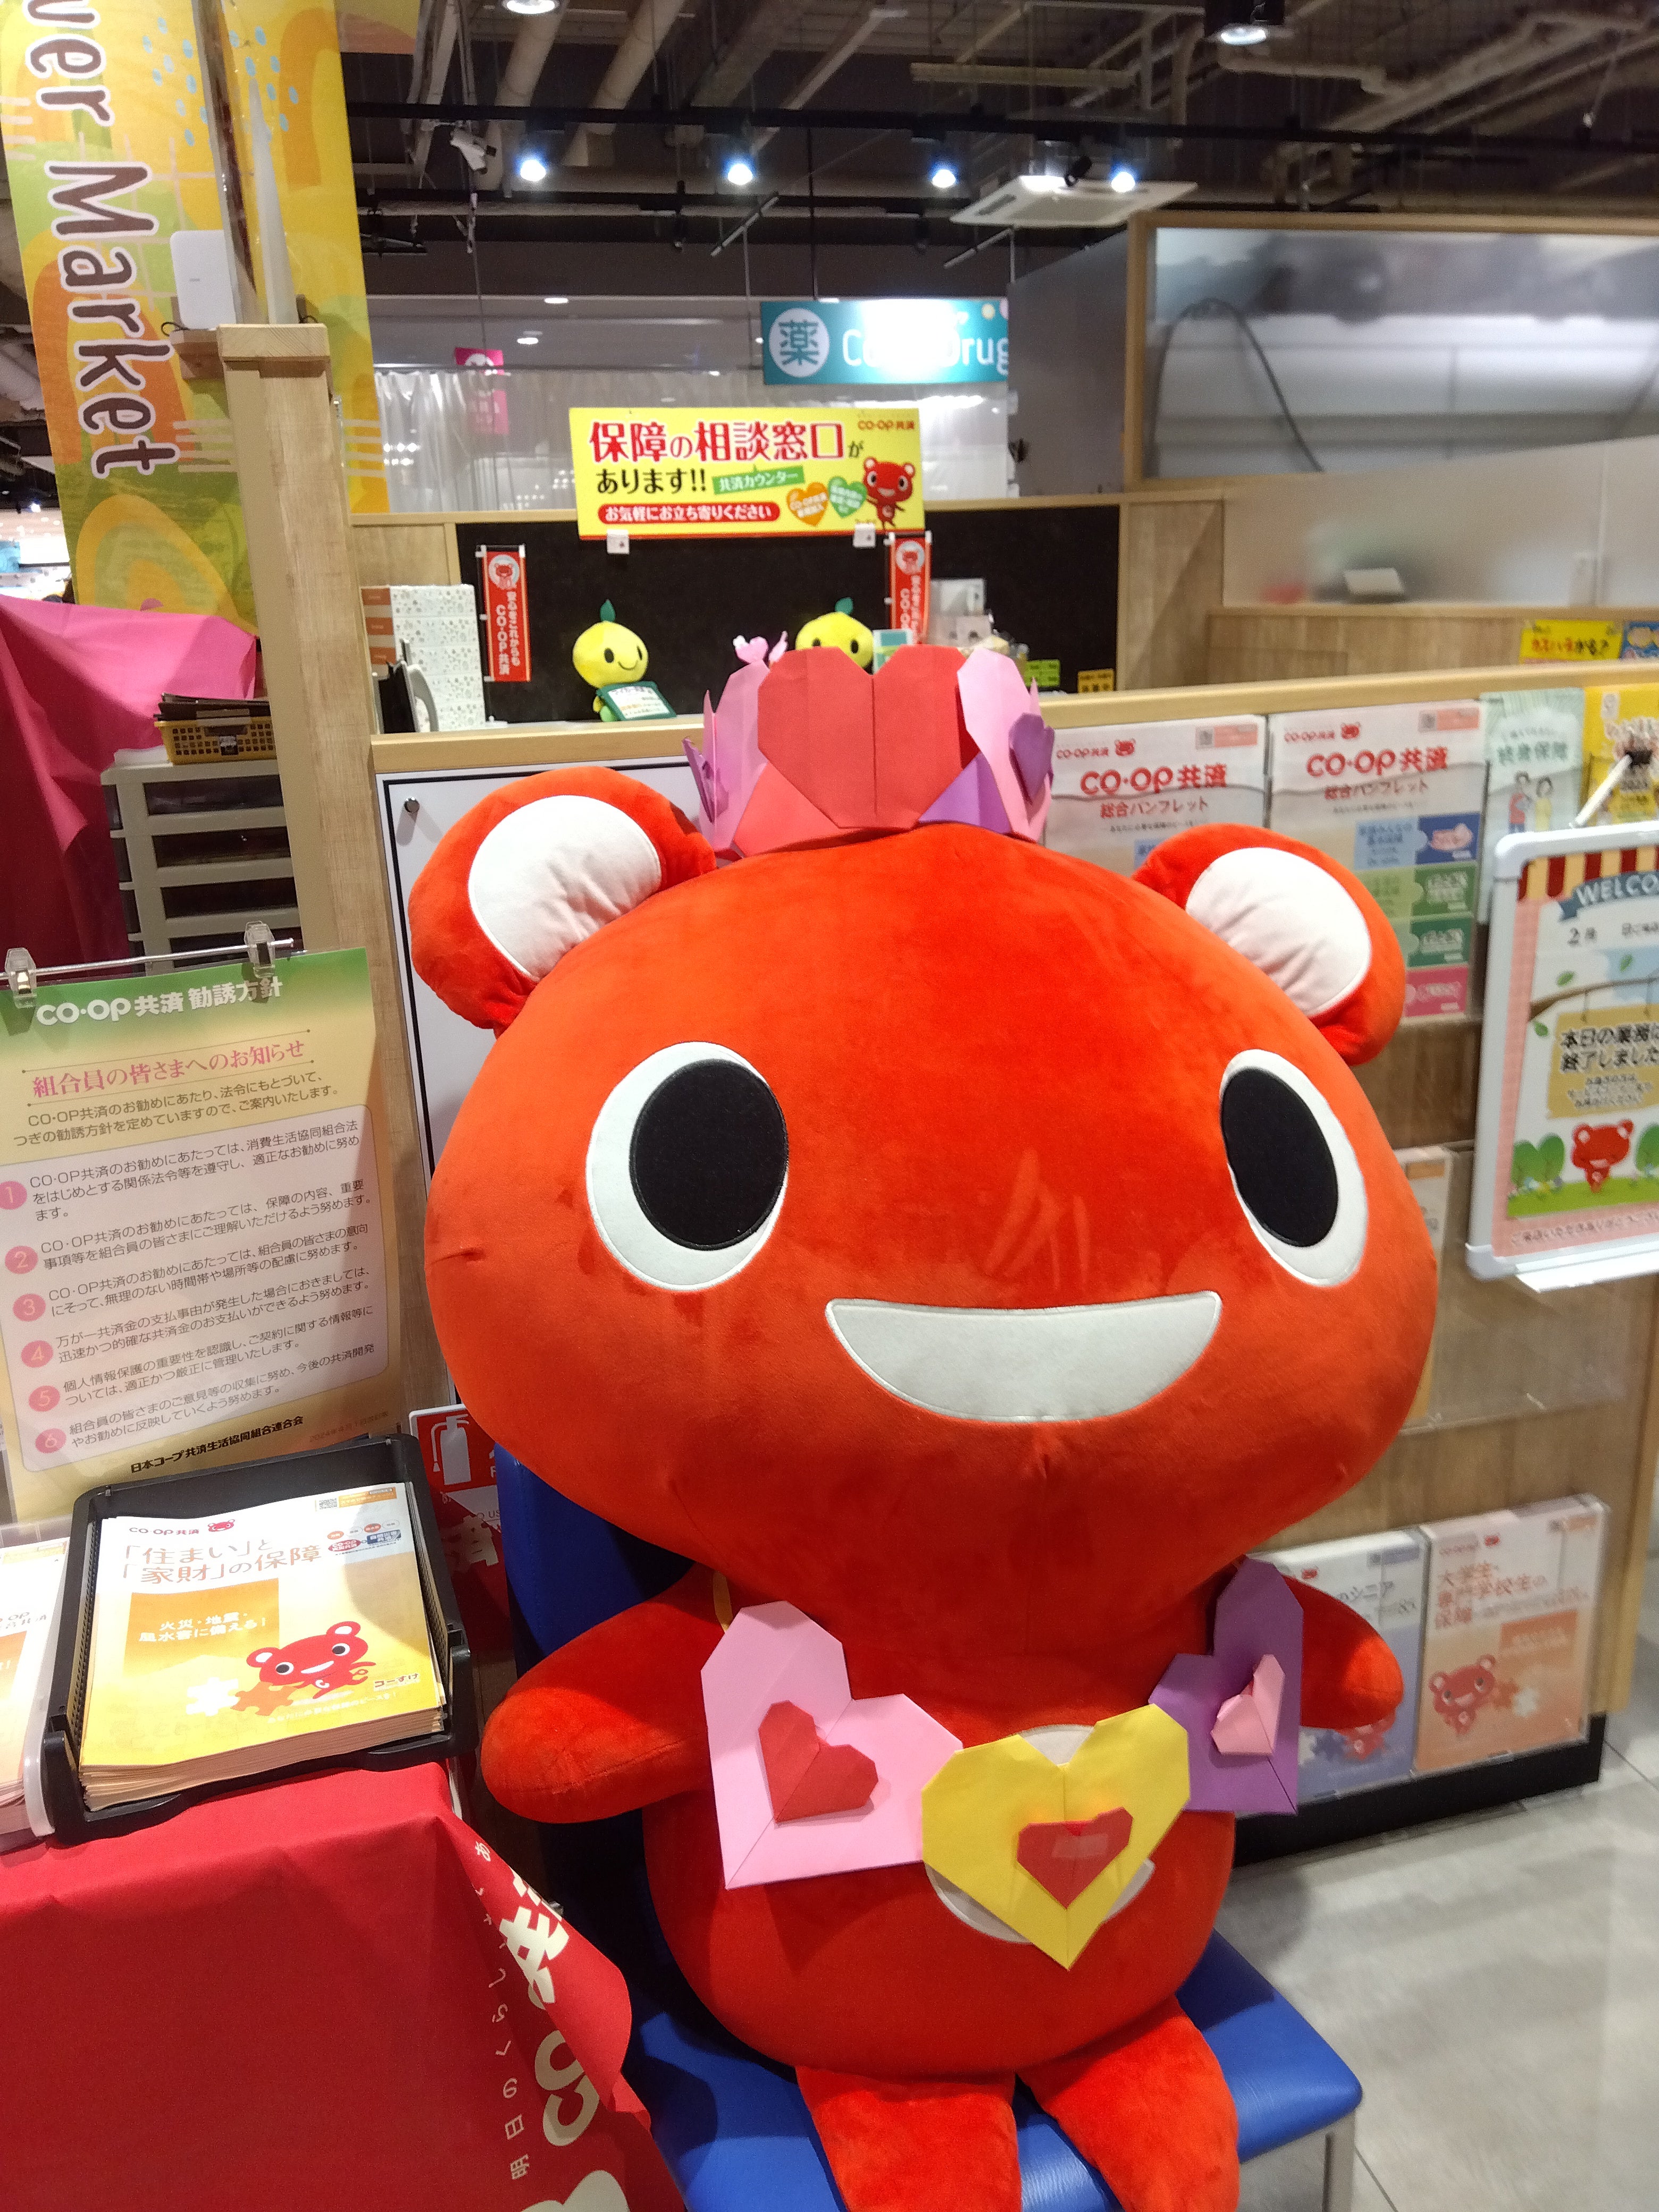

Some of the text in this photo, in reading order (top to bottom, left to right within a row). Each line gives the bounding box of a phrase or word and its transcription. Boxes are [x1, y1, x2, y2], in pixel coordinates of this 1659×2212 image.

[47, 163, 178, 476] Market
[778, 319, 819, 365] 薬
[605, 505, 773, 522] お気軽にお立ち寄りください
[188, 977, 283, 1009] 勧誘方針
[32, 1040, 305, 1098] 組合員の皆さまへのお知らせ
[35, 1206, 68, 1221] ます。
[131, 1415, 304, 1473] 日本コープ共済生活協同組合連合会
[123, 1545, 321, 1584] 「家財」の保障
[374, 1673, 418, 1688] コーすけ
